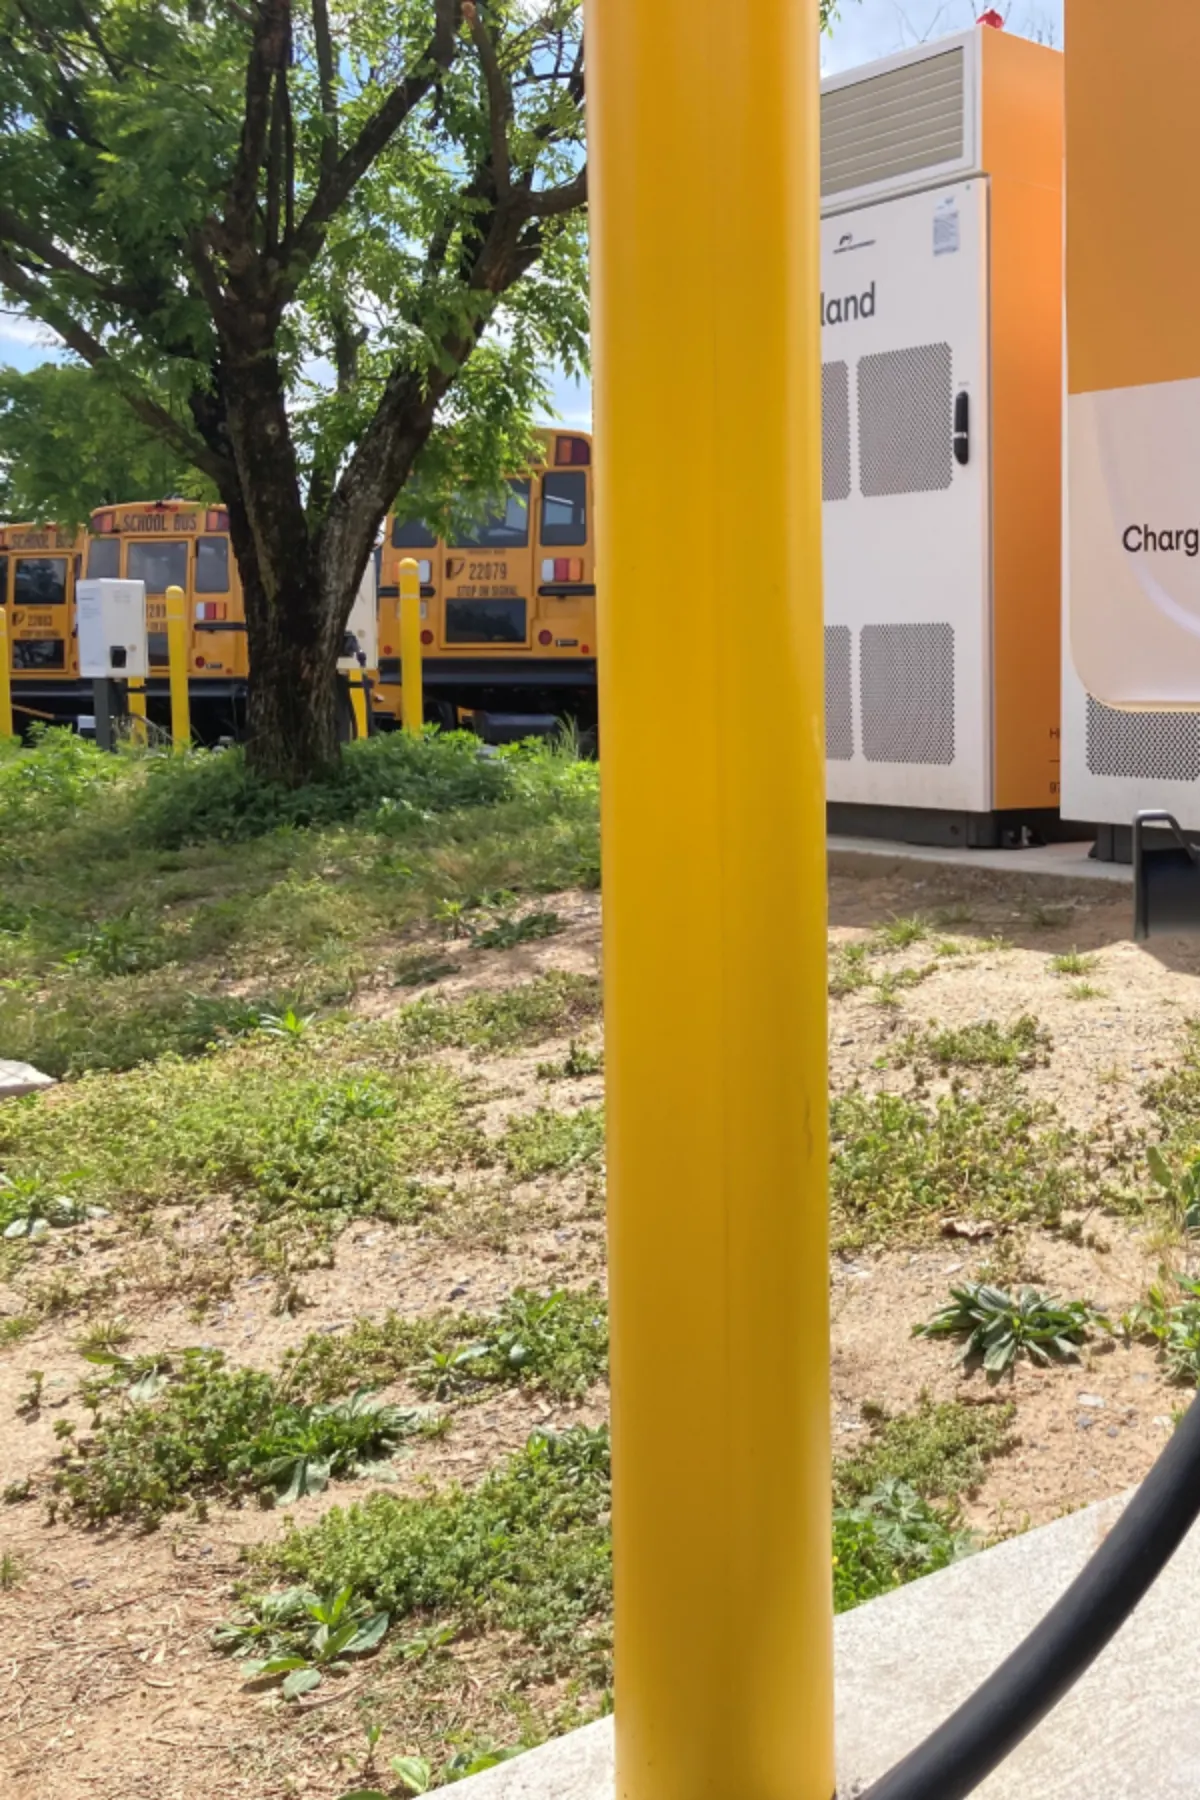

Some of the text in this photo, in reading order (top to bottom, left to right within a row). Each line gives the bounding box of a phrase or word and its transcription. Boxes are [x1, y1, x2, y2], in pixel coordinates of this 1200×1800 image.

[123, 512, 197, 532] SCHOOL BUS
[469, 561, 508, 581] 22079
